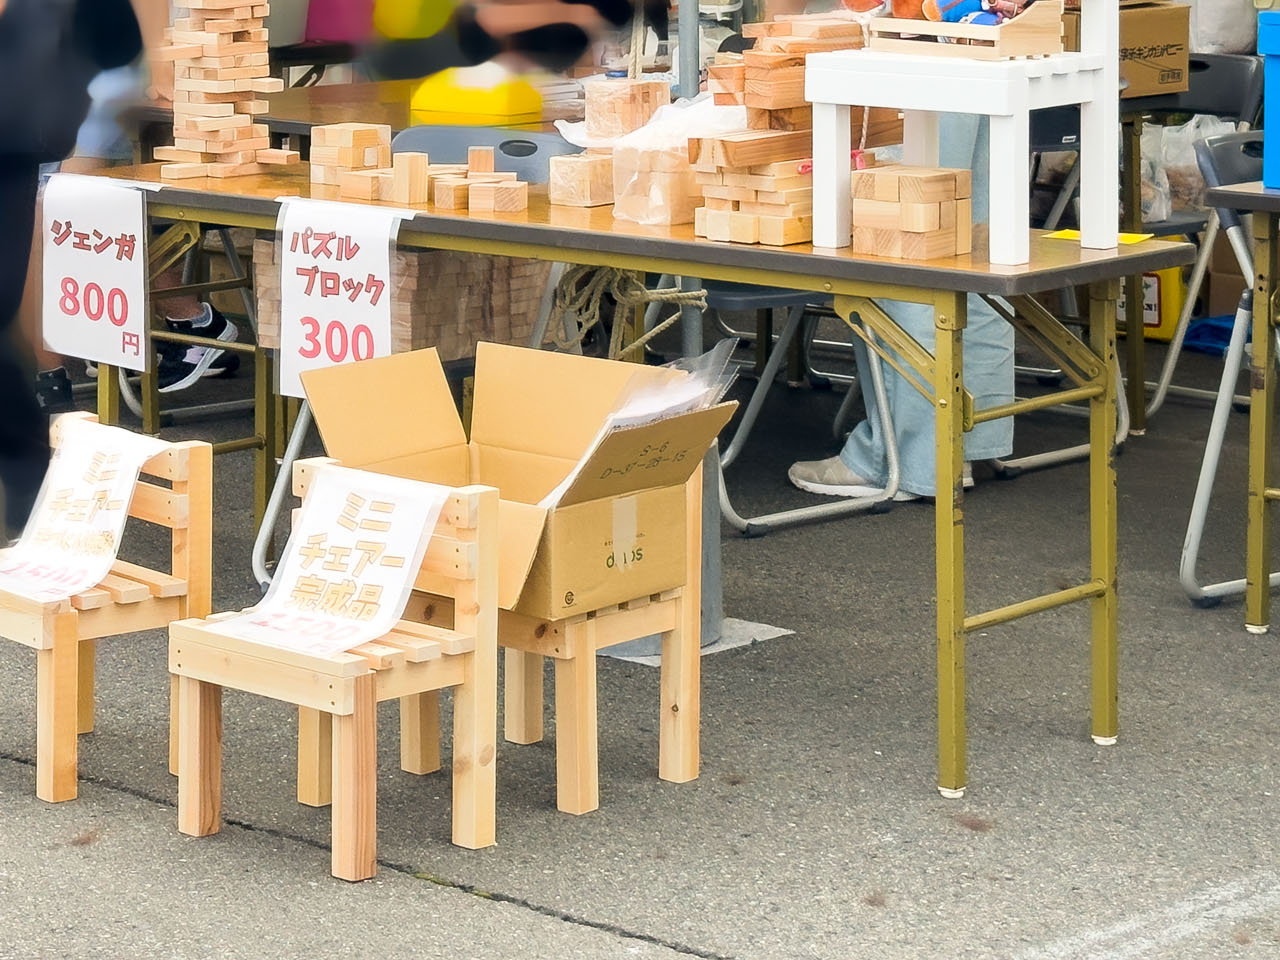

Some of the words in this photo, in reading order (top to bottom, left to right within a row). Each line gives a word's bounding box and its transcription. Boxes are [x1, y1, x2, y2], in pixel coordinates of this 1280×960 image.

[50, 218, 137, 262] ジェンガ
[289, 226, 360, 262] パズル
[295, 265, 385, 306] ブロック
[297, 315, 375, 363] 300
[336, 492, 396, 532] ミニ
[299, 533, 406, 578] チェアー
[284, 573, 385, 622] 完成品
